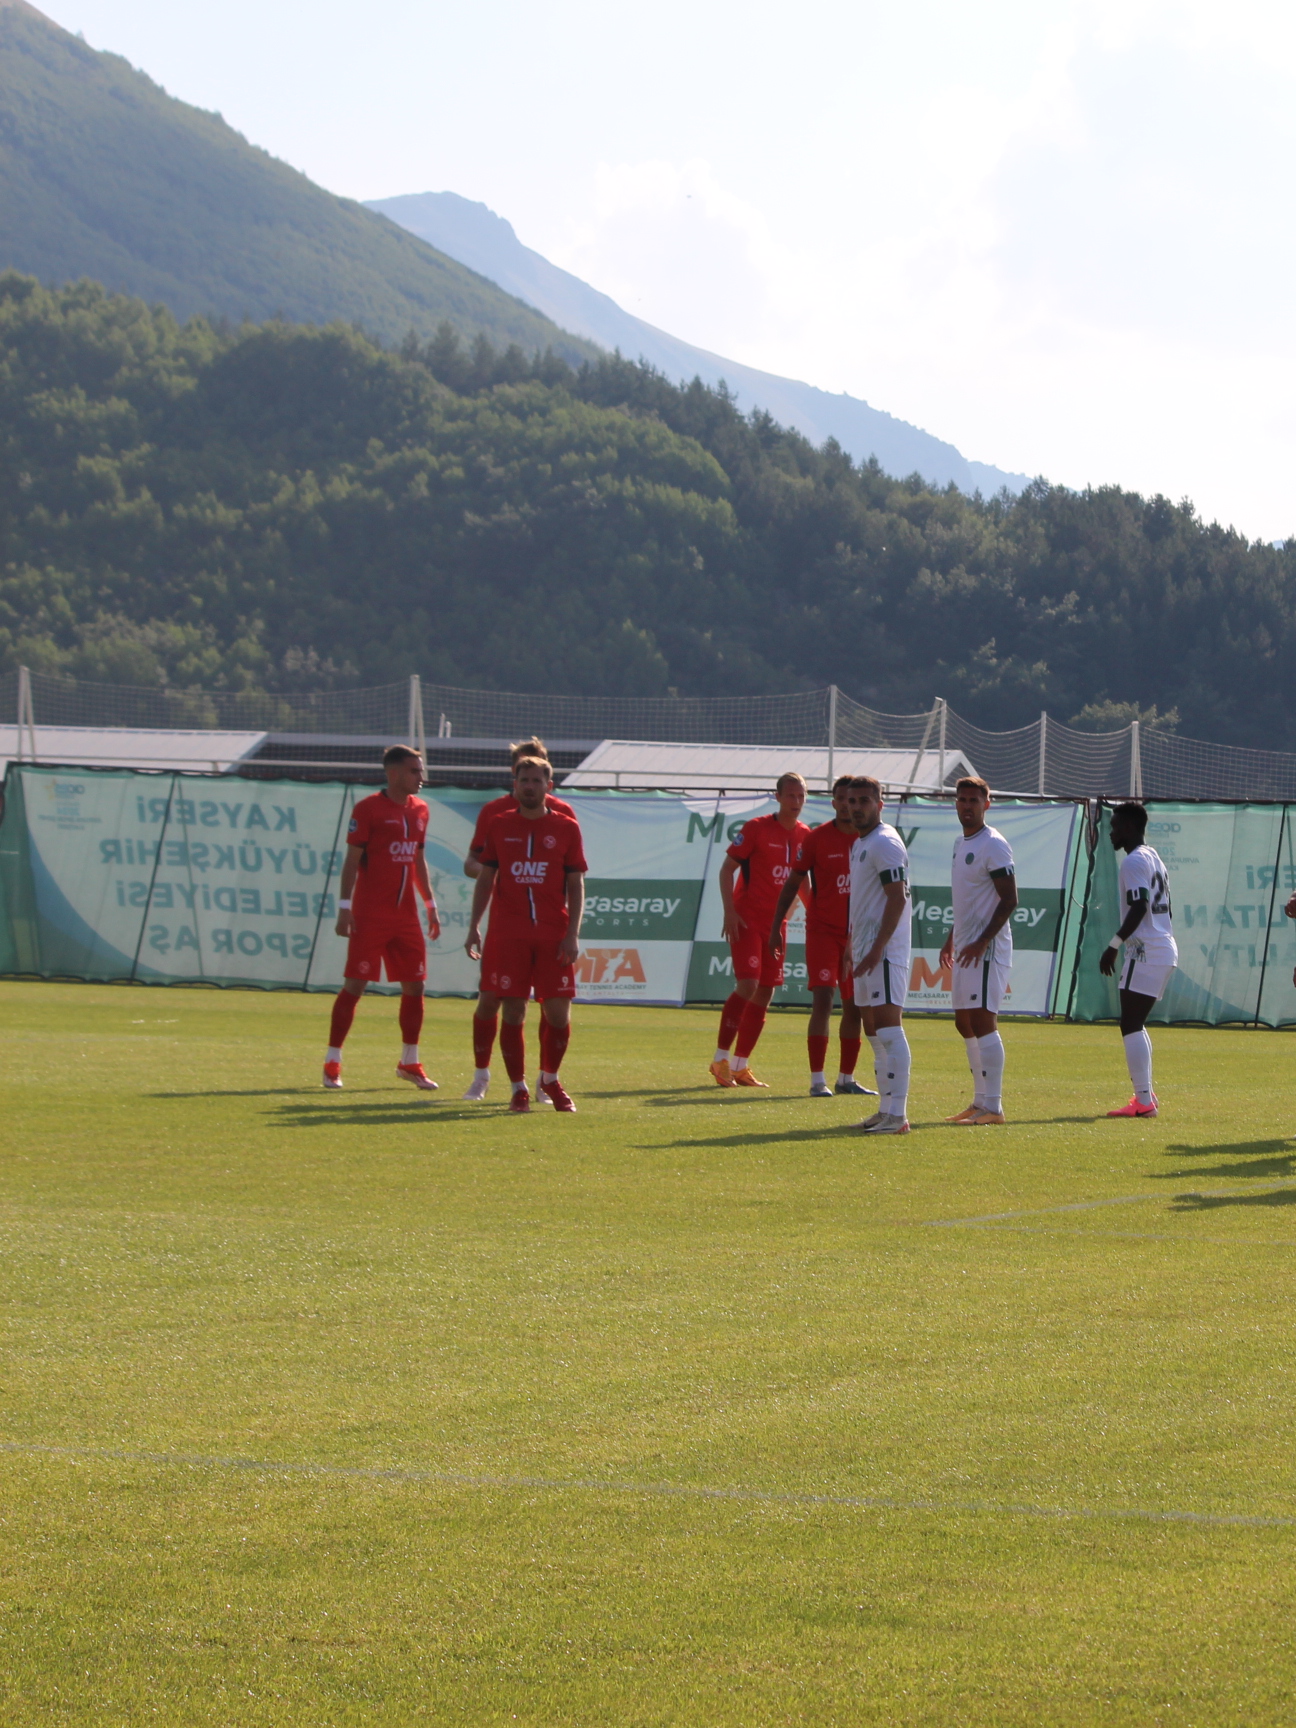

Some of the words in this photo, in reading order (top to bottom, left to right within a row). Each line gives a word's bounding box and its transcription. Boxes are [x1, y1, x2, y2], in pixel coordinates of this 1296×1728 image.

[511, 861, 549, 876] ONE
[515, 876, 544, 884] CASINO
[584, 895, 681, 917] gasaray
[911, 901, 1047, 927] Megay
[582, 918, 650, 926] PORTS
[561, 976, 569, 987] 9
